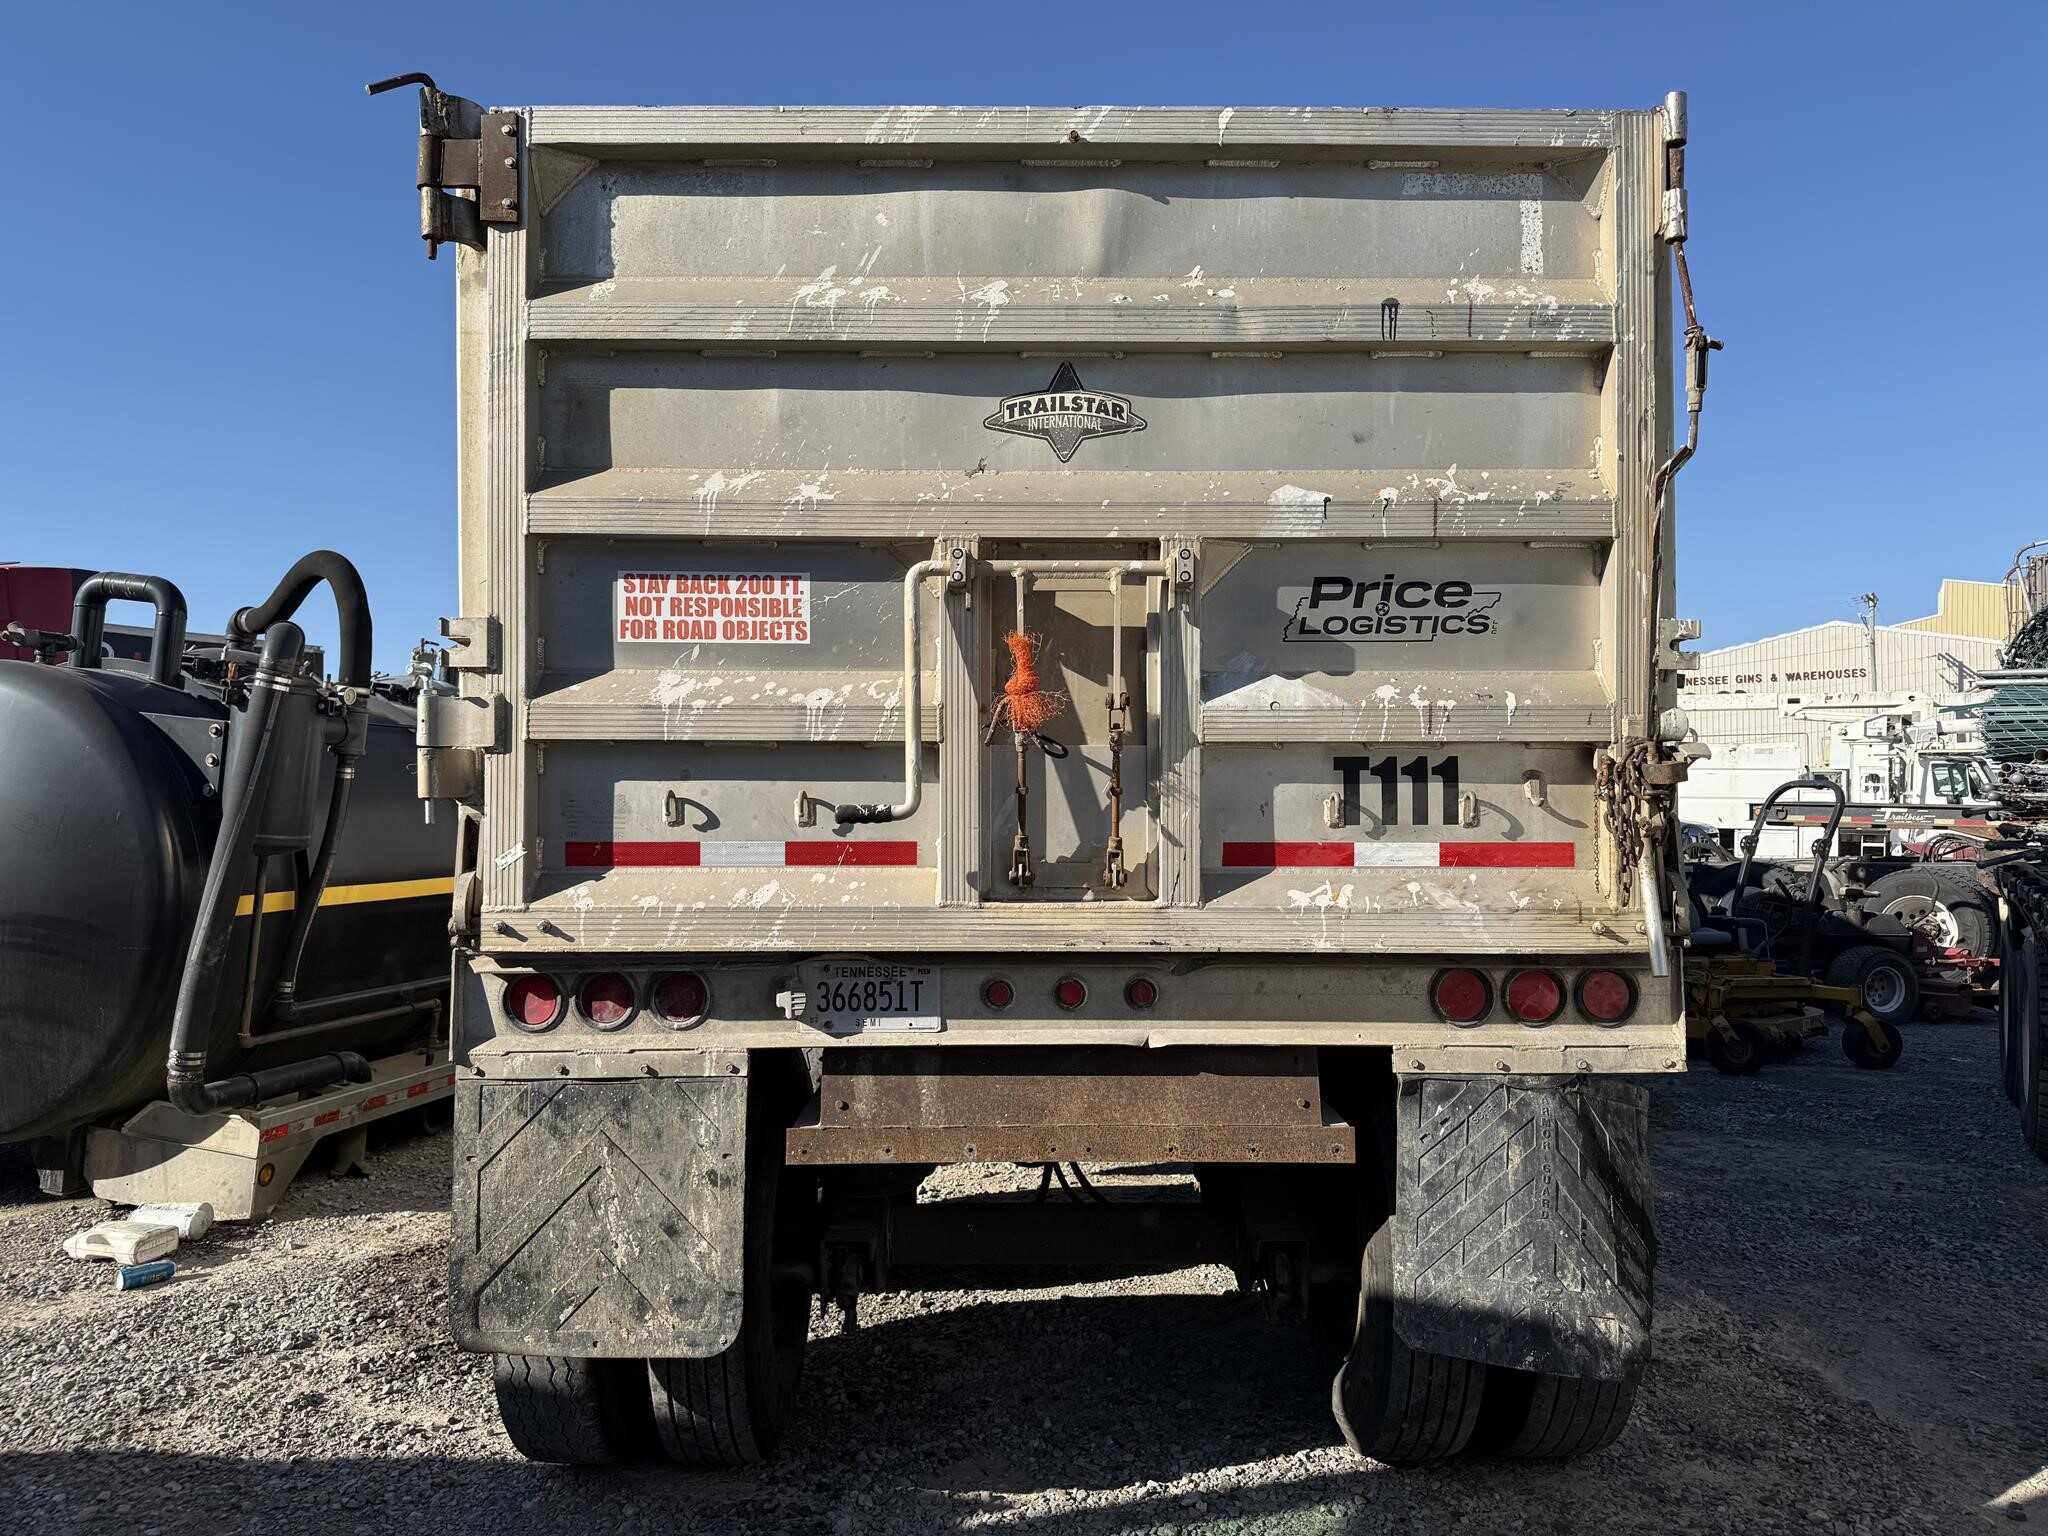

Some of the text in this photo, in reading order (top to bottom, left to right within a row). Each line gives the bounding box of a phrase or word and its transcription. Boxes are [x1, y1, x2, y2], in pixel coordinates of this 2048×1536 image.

[1006, 396, 1125, 420] TRAILSTAR
[1028, 415, 1103, 431] INTERNATIONAL
[623, 574, 805, 595] STAY BACK 200 FT.
[1309, 574, 1472, 609] Price
[625, 597, 803, 618] NOT RESPONSIBLE
[620, 619, 808, 641] FOR ROAD OBJECTS
[1298, 615, 1491, 635] LOGISTICS
[1735, 673, 1763, 684] GINS
[1770, 673, 1778, 682] &
[1785, 668, 1867, 682] WAREHOUSES
[1334, 756, 1459, 825] T111
[835, 966, 907, 978] TENNESSEE
[816, 980, 924, 1012] 366851T
[856, 1017, 881, 1027] SEMI
